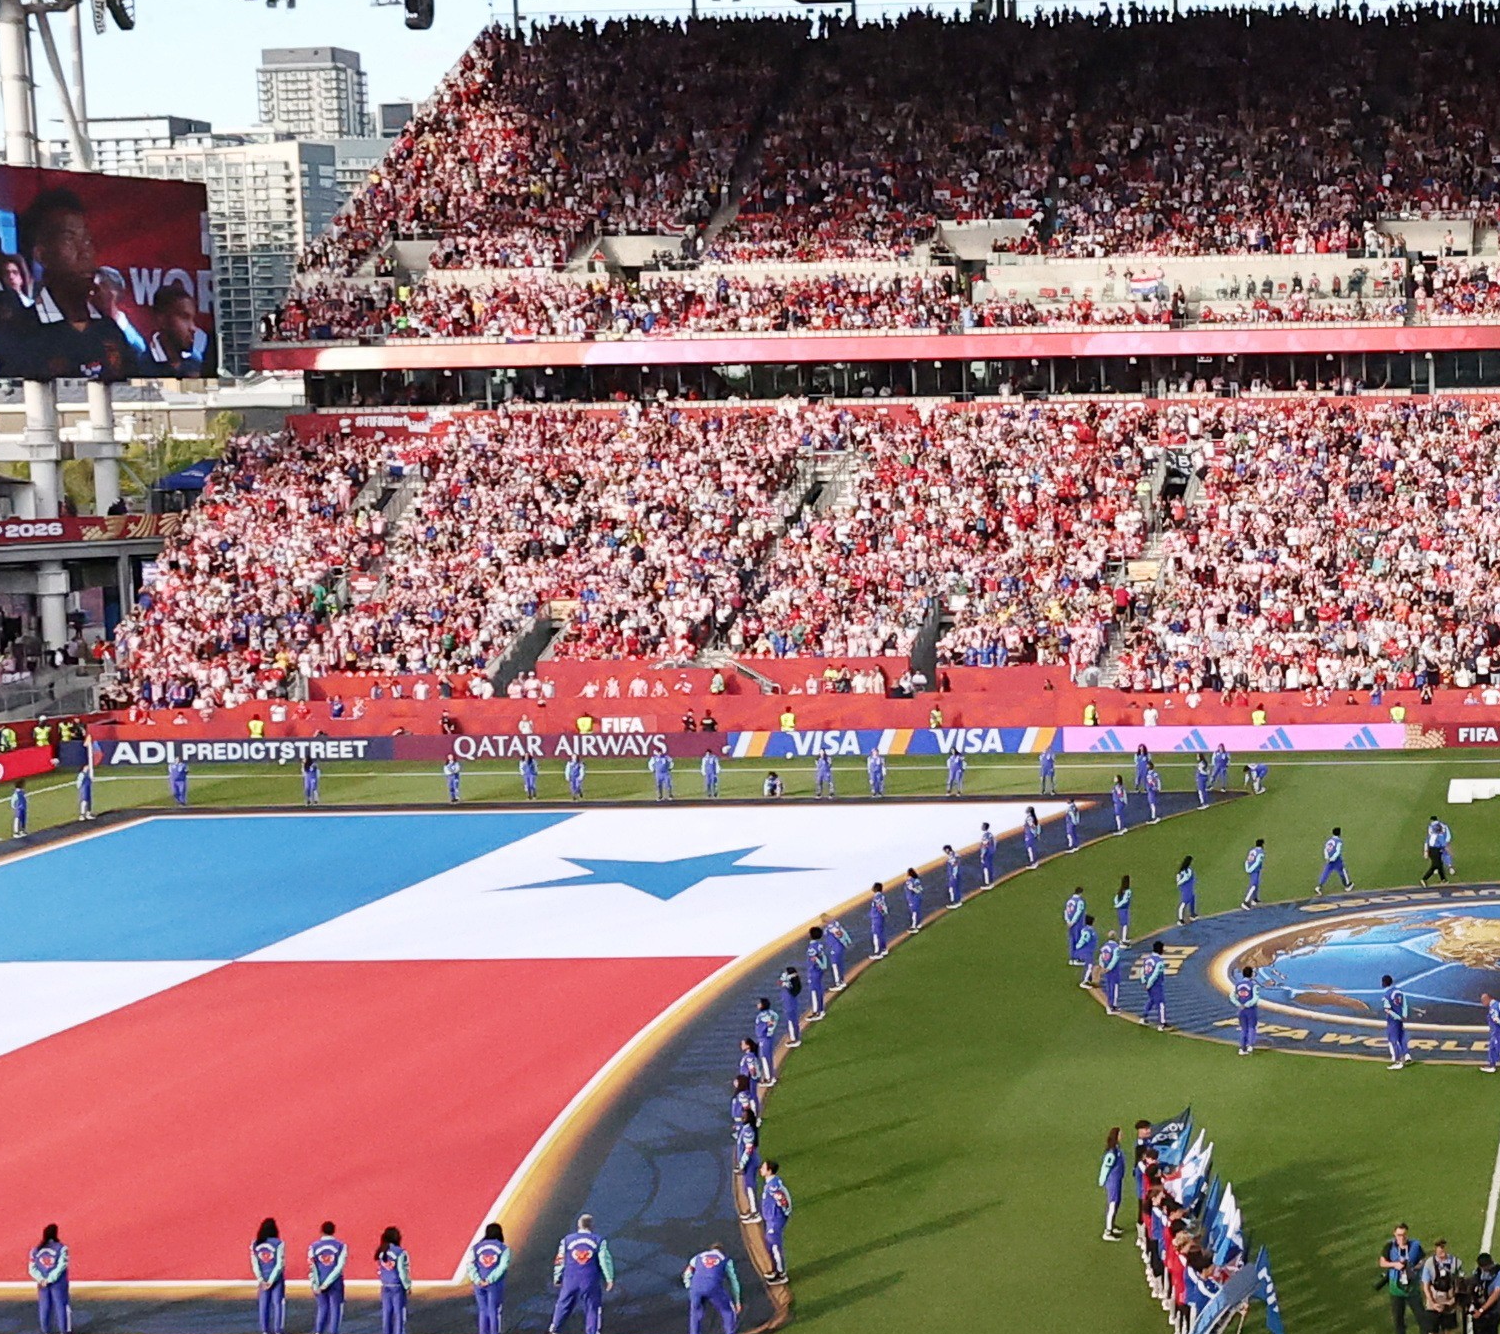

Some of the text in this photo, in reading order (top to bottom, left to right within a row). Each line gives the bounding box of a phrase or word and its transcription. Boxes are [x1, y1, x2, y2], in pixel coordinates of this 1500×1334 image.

[5, 522, 64, 540] 2026
[601, 717, 645, 734] FIFA
[1457, 727, 1500, 745] FIFA
[111, 740, 368, 766] ADI PREDICTSTREET
[453, 733, 668, 760] QATAR AIRWAYS
[788, 729, 861, 757] VISA
[931, 727, 1002, 755] VISA
[1212, 1016, 1311, 1040] FFA
